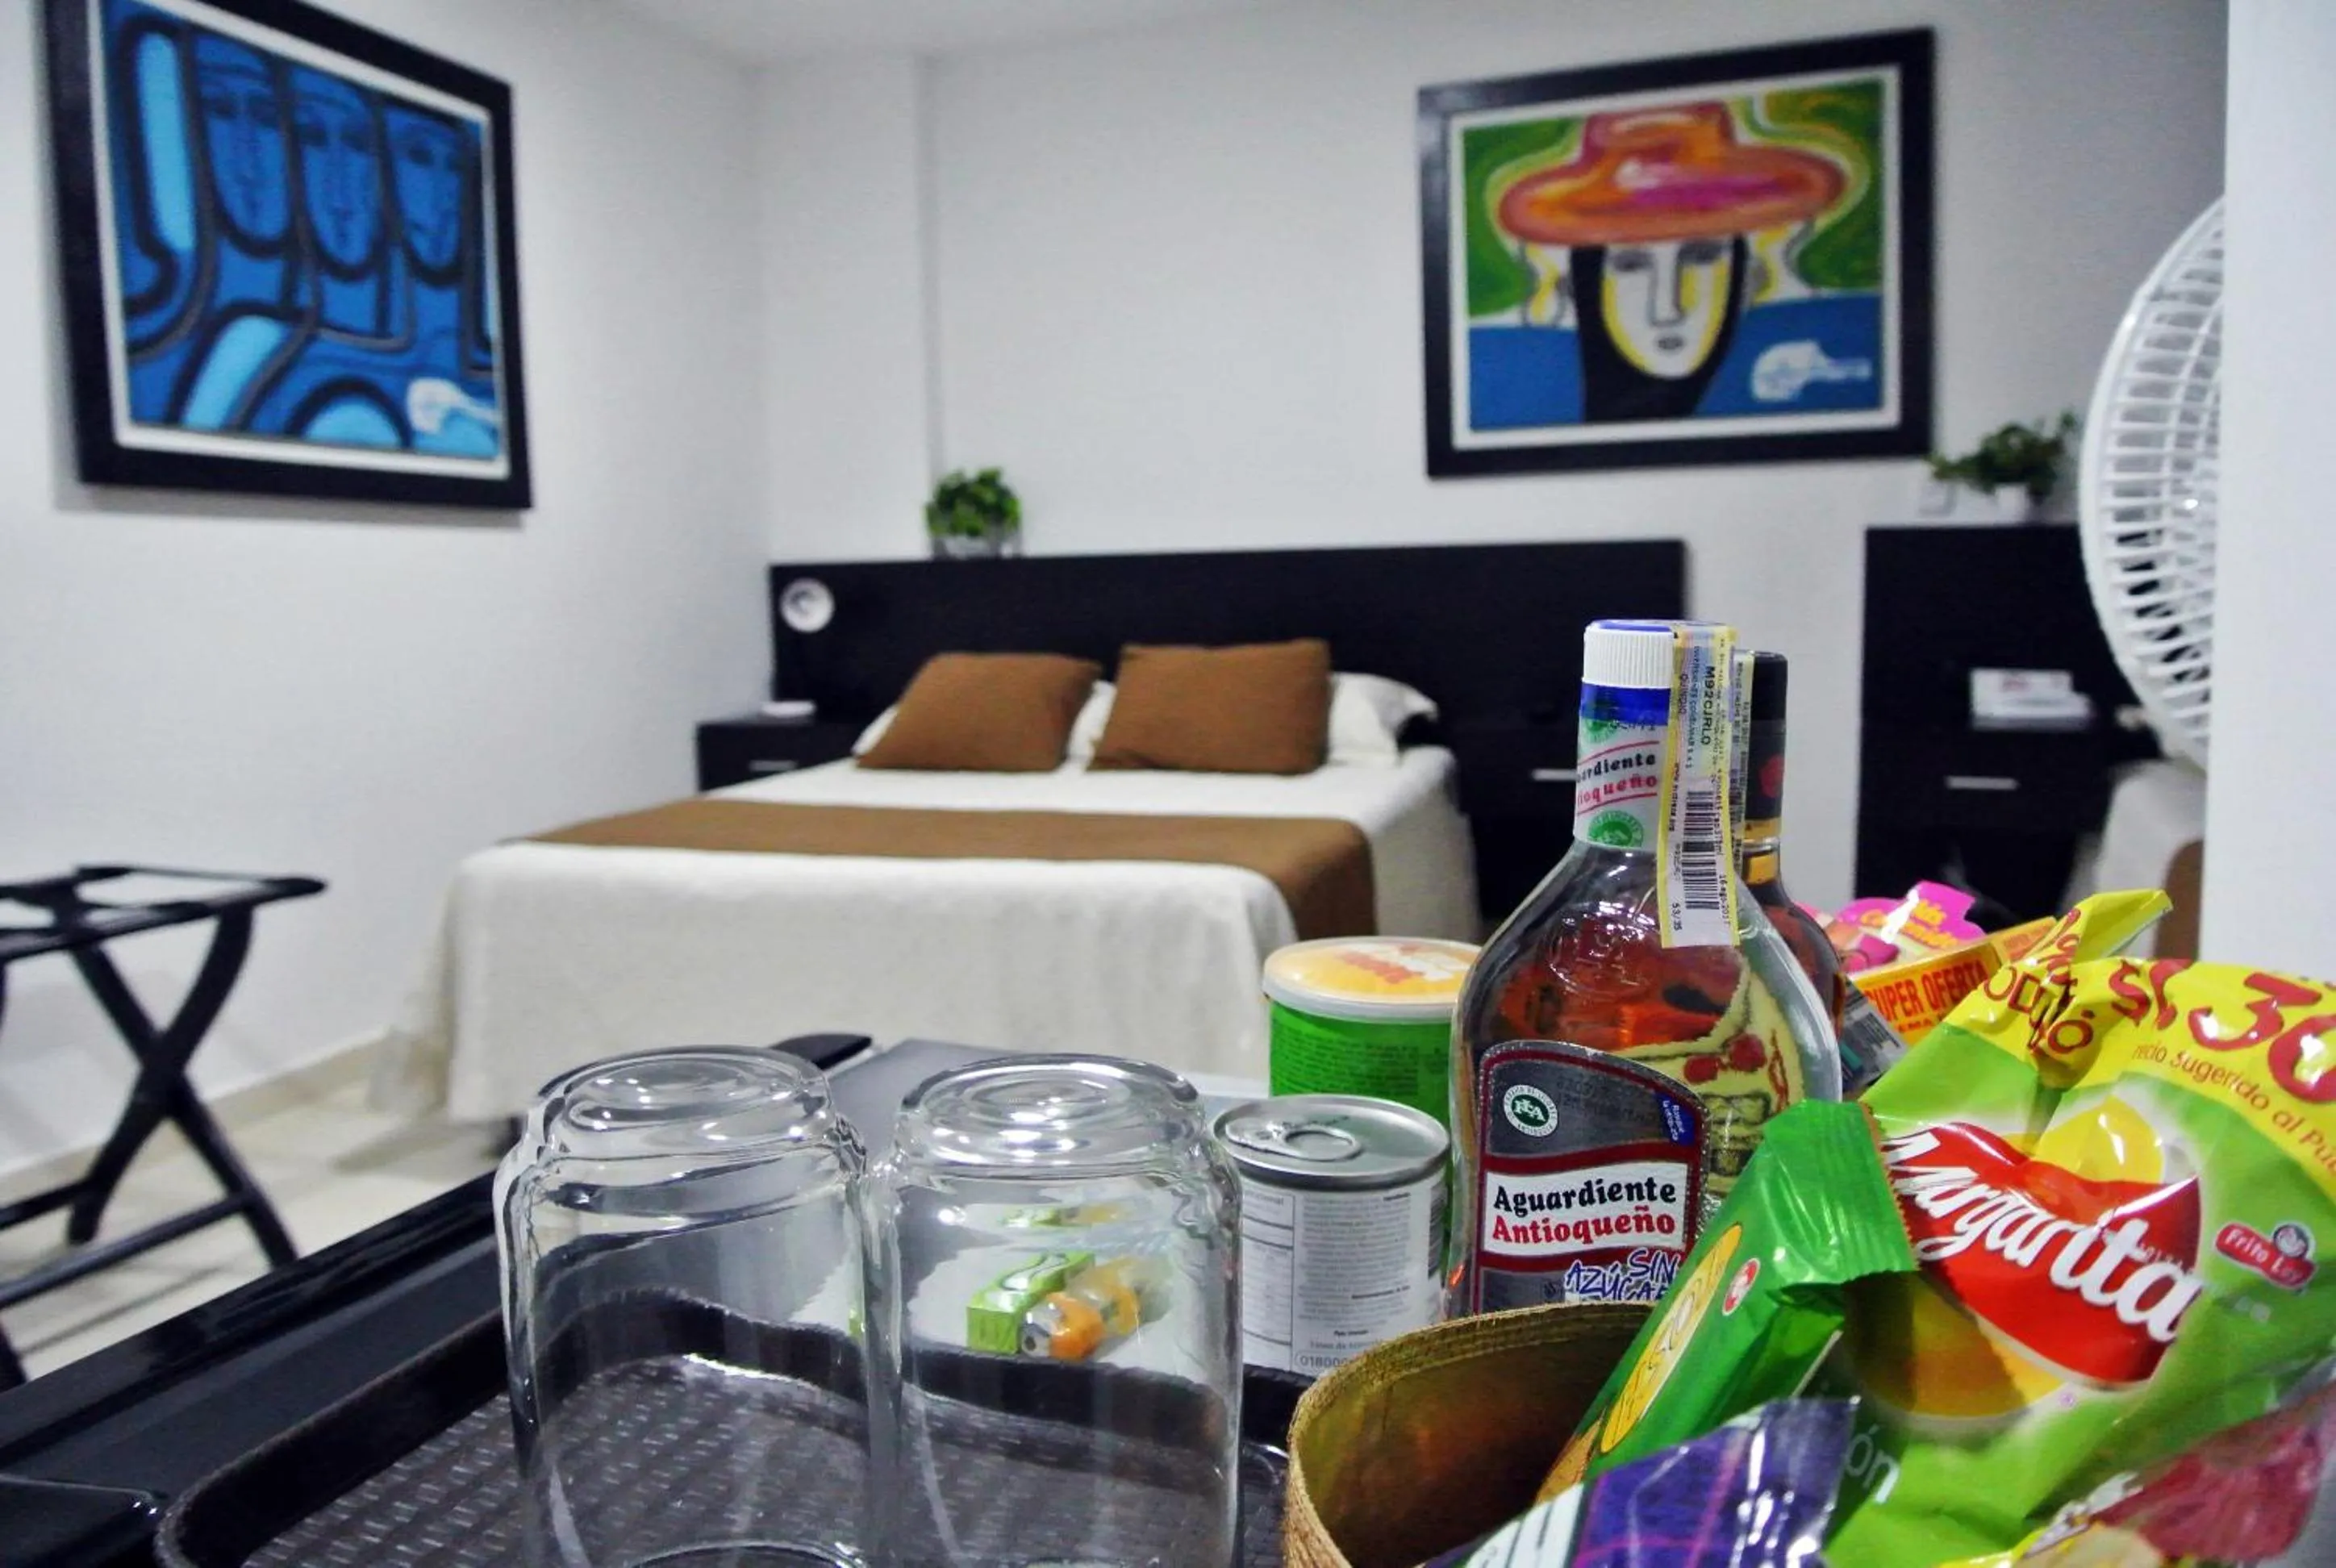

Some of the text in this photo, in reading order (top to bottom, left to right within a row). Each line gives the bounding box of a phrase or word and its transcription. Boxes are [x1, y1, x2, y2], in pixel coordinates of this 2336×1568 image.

[2272, 1111, 2306, 1134] al
[1493, 1176, 1676, 1217] Aguardiente
[1492, 1206, 1675, 1245] Antioqueño
[2225, 1228, 2269, 1263] Frito
[1628, 1249, 1679, 1284] SIN
